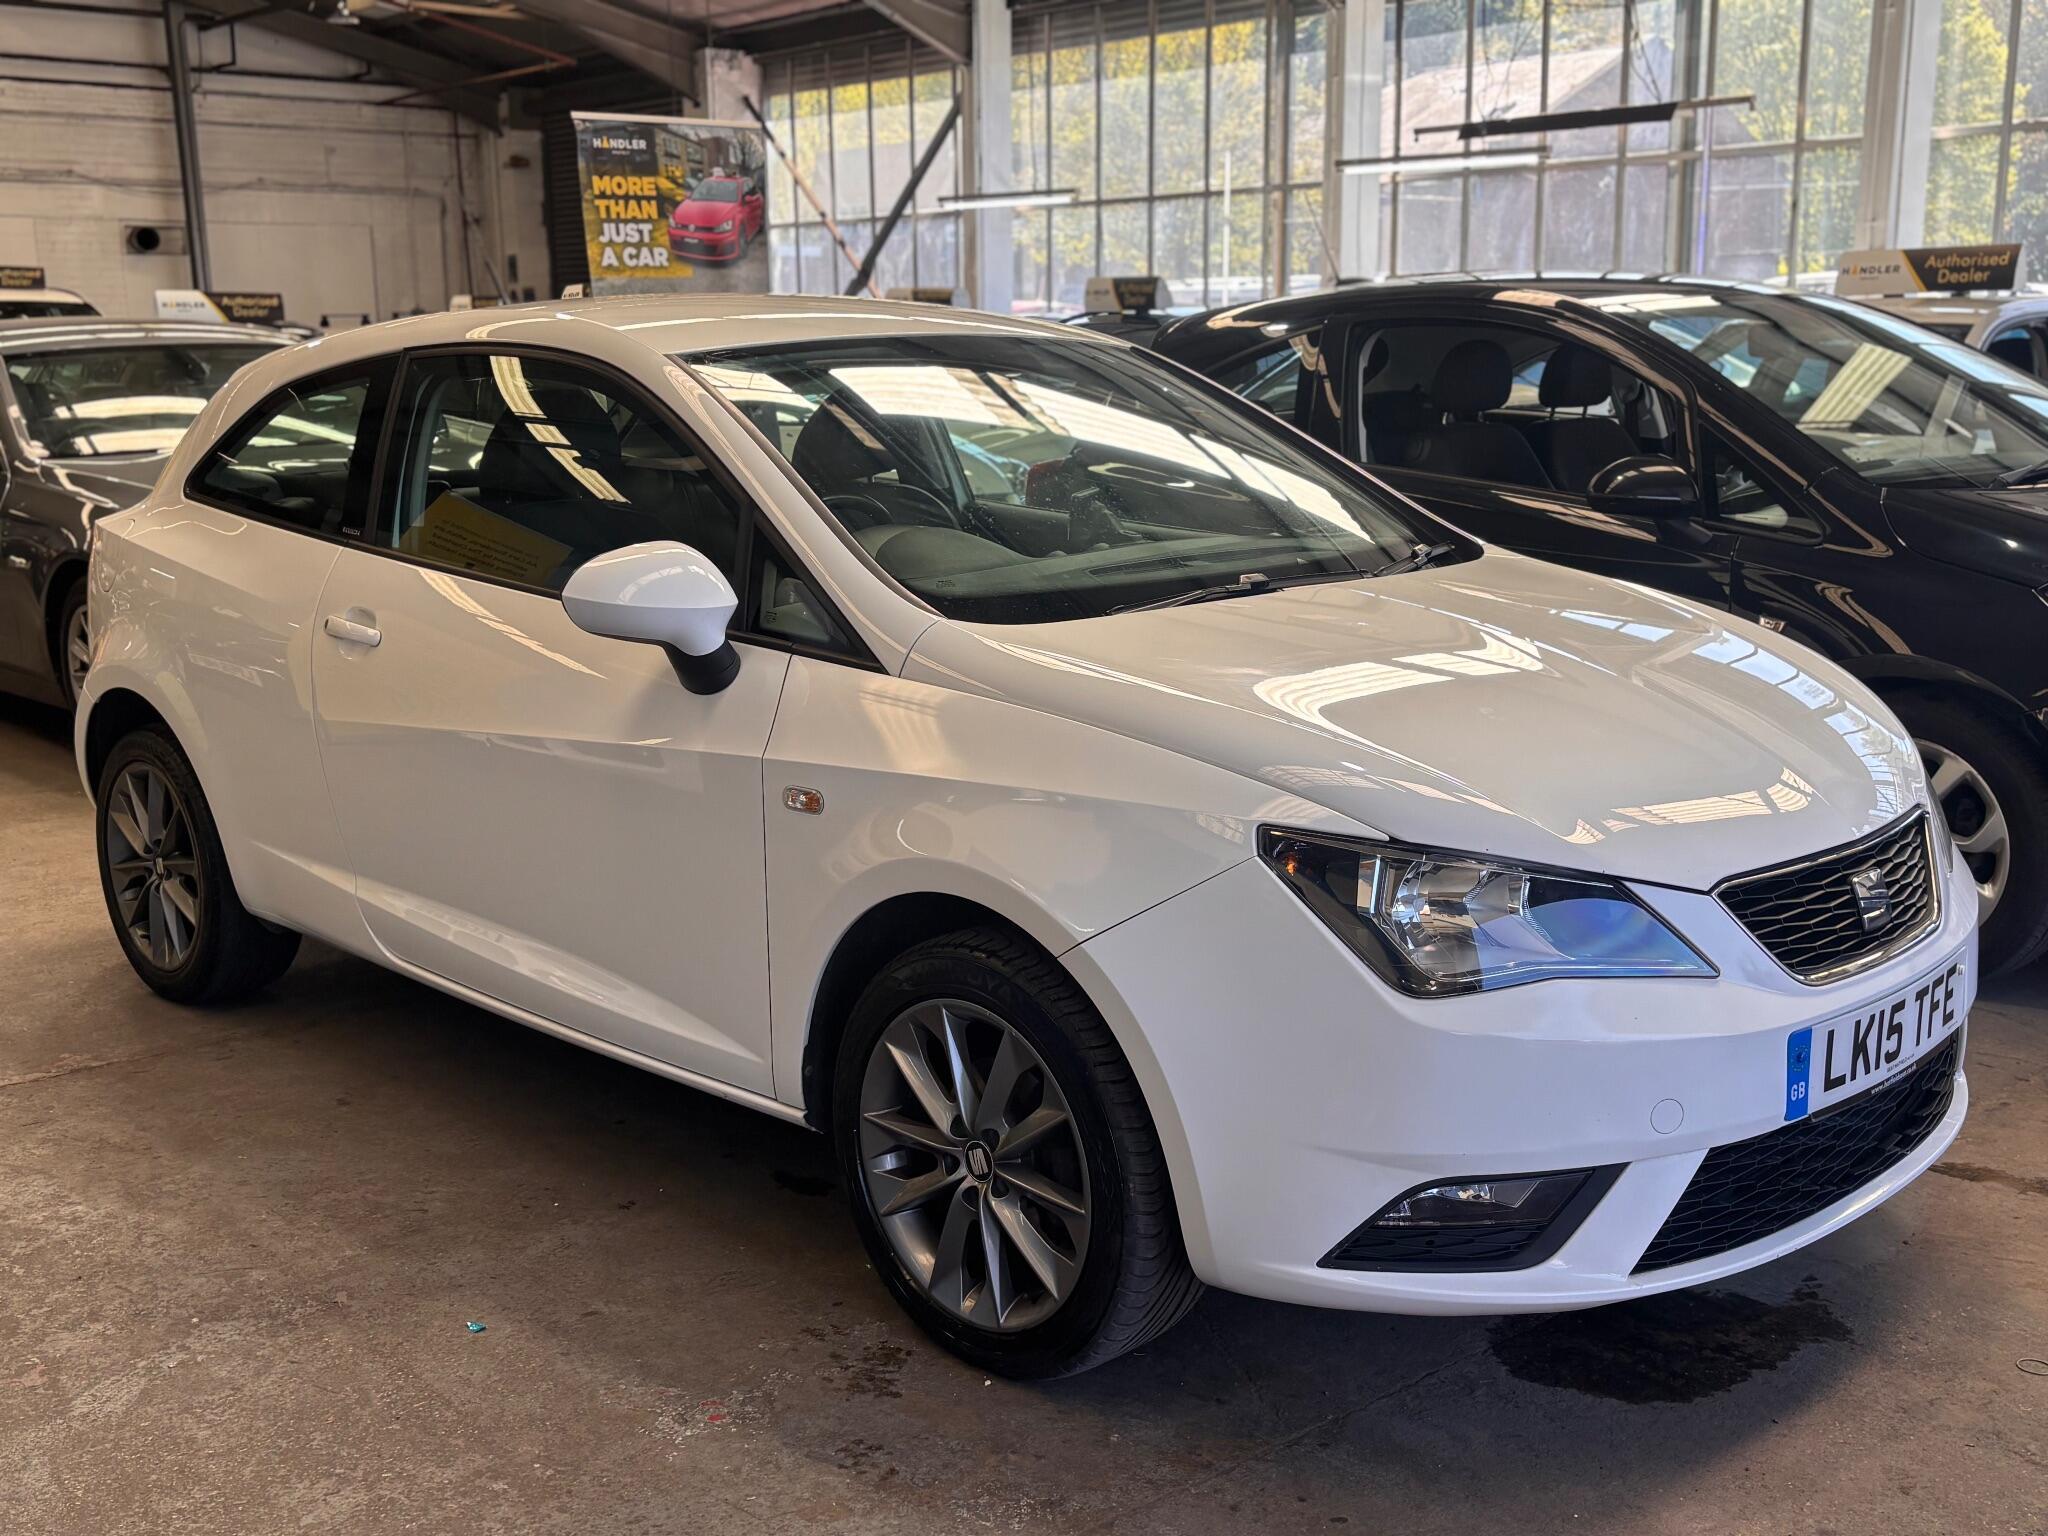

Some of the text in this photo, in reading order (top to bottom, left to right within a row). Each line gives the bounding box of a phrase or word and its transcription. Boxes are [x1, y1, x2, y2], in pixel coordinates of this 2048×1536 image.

[592, 175, 657, 197] MORE
[594, 199, 659, 220] THAN
[599, 222, 653, 243] JUST
[601, 247, 669, 267] A CAR
[1924, 251, 2010, 269] Authorised
[1937, 269, 1990, 285] Dealer
[221, 296, 279, 307] Authorised
[233, 305, 269, 317] Dealer
[1824, 963, 1958, 1092] LK15 TFE
[1790, 1081, 1805, 1101] GB
